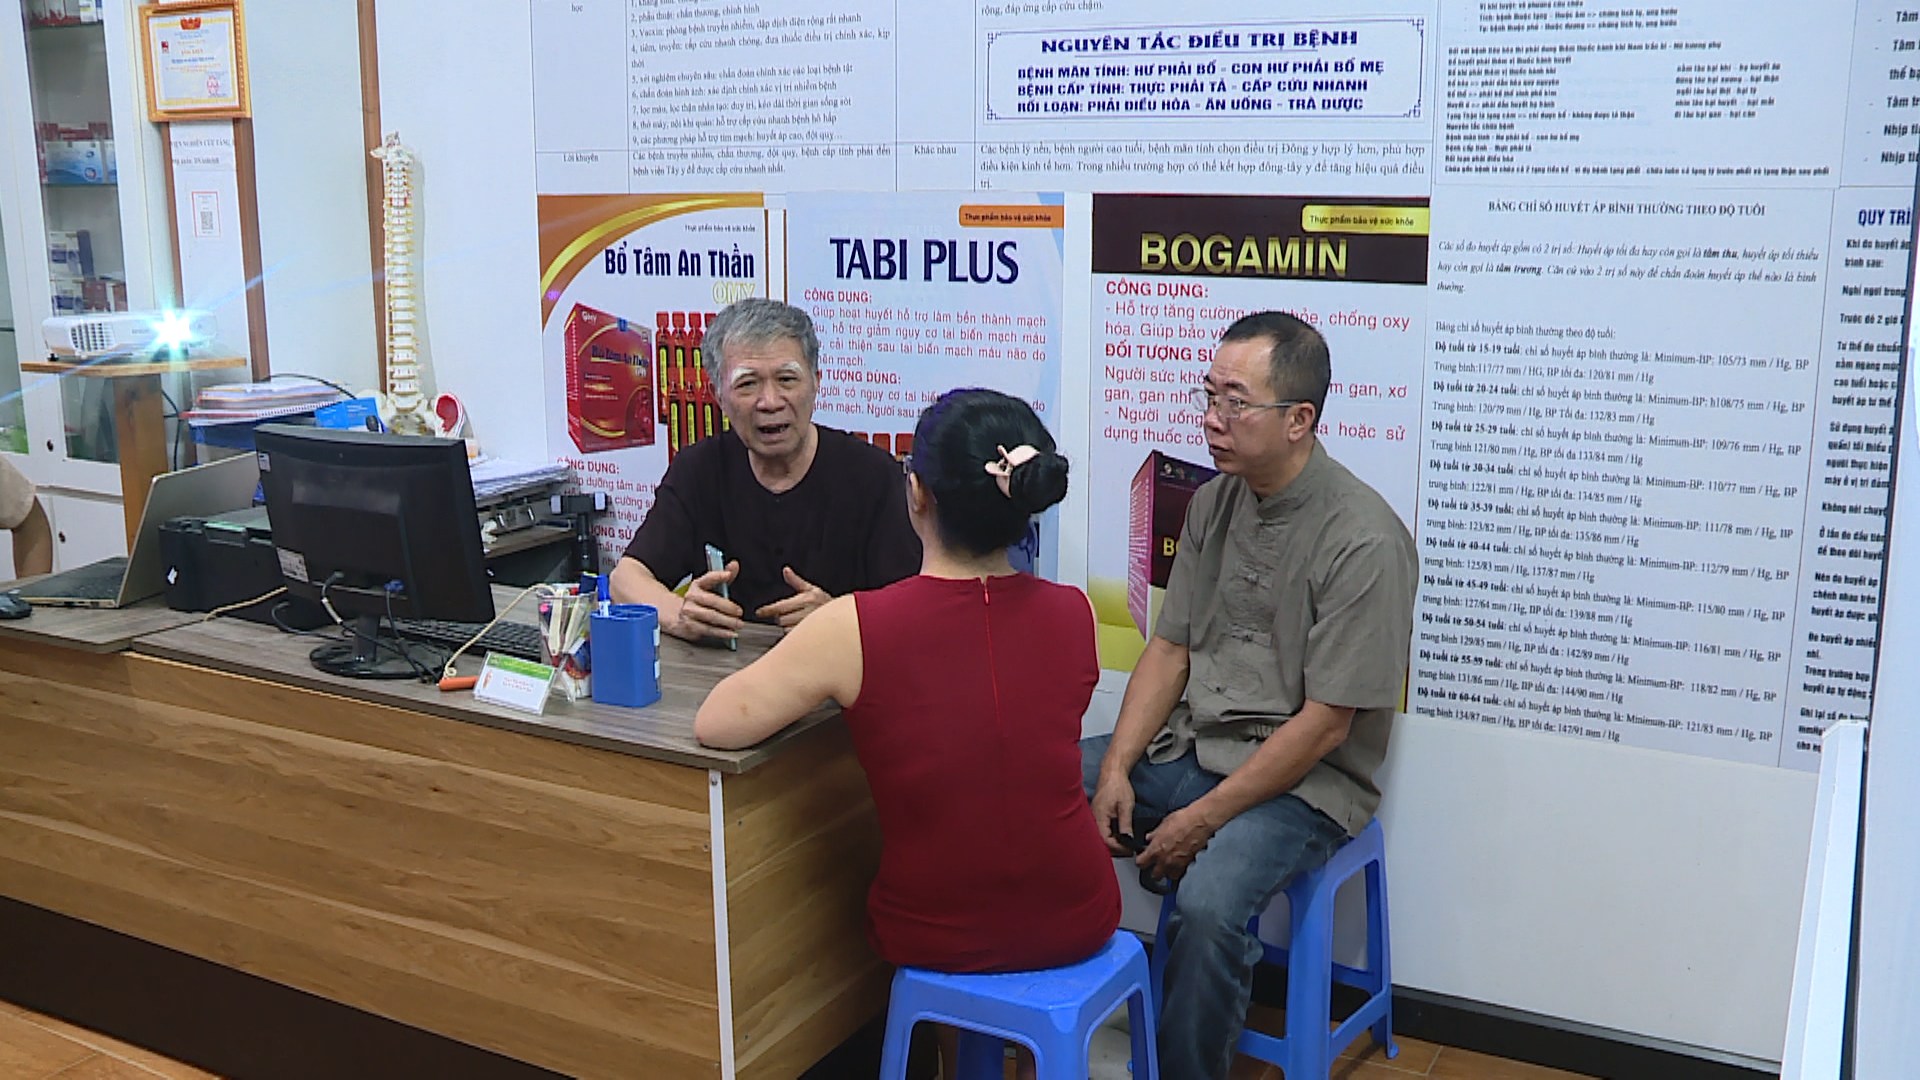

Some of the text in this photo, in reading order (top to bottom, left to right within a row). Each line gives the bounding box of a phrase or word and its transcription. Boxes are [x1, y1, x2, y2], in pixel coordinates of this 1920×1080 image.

[1041, 35, 1129, 53] NGUYÊN
[1137, 31, 1180, 50] TẮC
[1247, 32, 1284, 49] TRỊ
[1293, 29, 1357, 48] BỆNH
[1094, 64, 1129, 77] TÍNH:
[1134, 63, 1155, 76] HƯ
[1231, 63, 1262, 74] CON
[1267, 61, 1289, 74] HƯ
[1360, 61, 1384, 75] MẸ
[1018, 83, 1053, 98] BỆNH
[1058, 81, 1084, 95] CẤP
[1089, 81, 1124, 94] TÍNH:
[1129, 81, 1165, 96] THỰC
[1242, 77, 1272, 92] CẤP
[1313, 79, 1367, 91] NHANH
[1231, 95, 1271, 110] UỐNG
[1322, 97, 1363, 112] DƯỢC
[1688, 205, 1716, 214] THEO
[1858, 209, 1884, 226] QUY
[604, 240, 754, 278] Bổ Tâm An Thần
[829, 238, 1018, 284] TABI PLUS
[1141, 233, 1346, 277] BOGAMIN
[804, 288, 871, 304] CÔNG DỤNG:
[1106, 278, 1207, 299] CÔNG DỤNG:
[812, 305, 834, 320] Giúp
[839, 307, 860, 320] hoạt
[865, 307, 892, 322] huyết
[915, 311, 928, 323] trợ
[933, 310, 951, 322] làm
[981, 312, 1011, 326] thành
[1017, 315, 1045, 329] mạch
[1116, 300, 1409, 331] Hỗ trợ tăng cường chống oxy
[849, 323, 861, 336] trợ
[866, 323, 890, 338] giảm
[895, 327, 920, 340] nguy
[925, 329, 937, 338] cơ
[943, 327, 954, 339] tai
[988, 331, 1016, 343] mạch
[1022, 331, 1045, 344] máu
[1105, 321, 1205, 339] hóa. Giúp bảo
[830, 339, 843, 349] cải
[848, 340, 872, 352] thiện
[877, 343, 894, 352] sau
[900, 342, 912, 354] tai
[945, 344, 972, 358] mạch
[978, 346, 1001, 358] máu
[1007, 347, 1026, 360] não
[1032, 349, 1045, 361] do
[1105, 343, 1191, 362] ĐỐI TƯỢNG
[826, 369, 900, 384] TƯỢNG DÙNG:
[1105, 365, 1407, 398] Người sức gan, xơ
[844, 386, 855, 398] có
[860, 389, 883, 402] nguy
[888, 391, 899, 401] cơ
[905, 390, 916, 402] tai
[1104, 389, 1164, 404] gan, gan
[836, 402, 914, 418] mạch. Người sau
[1118, 405, 1405, 440] Người uống hoặc sử
[1104, 425, 1203, 445] dụng thuốc có
[587, 461, 619, 474] DỤNG:
